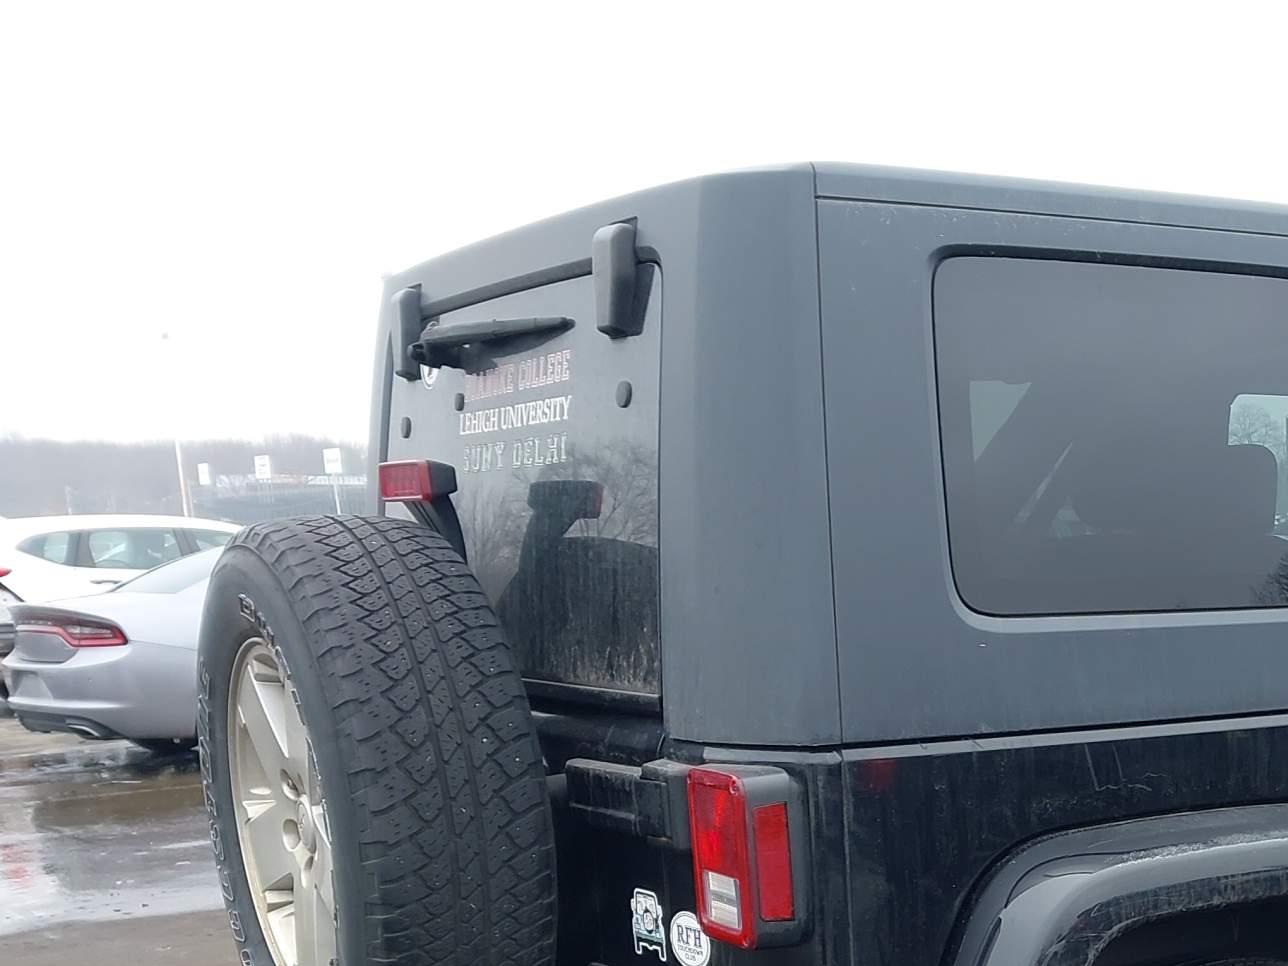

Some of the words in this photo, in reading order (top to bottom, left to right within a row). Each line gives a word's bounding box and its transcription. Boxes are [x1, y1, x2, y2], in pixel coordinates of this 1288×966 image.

[518, 349, 572, 390] COLLEGE
[459, 408, 499, 435] LEHIGH
[500, 395, 572, 430] UNIVERSITY
[511, 432, 568, 468] DELHI
[676, 924, 703, 949] RFH
